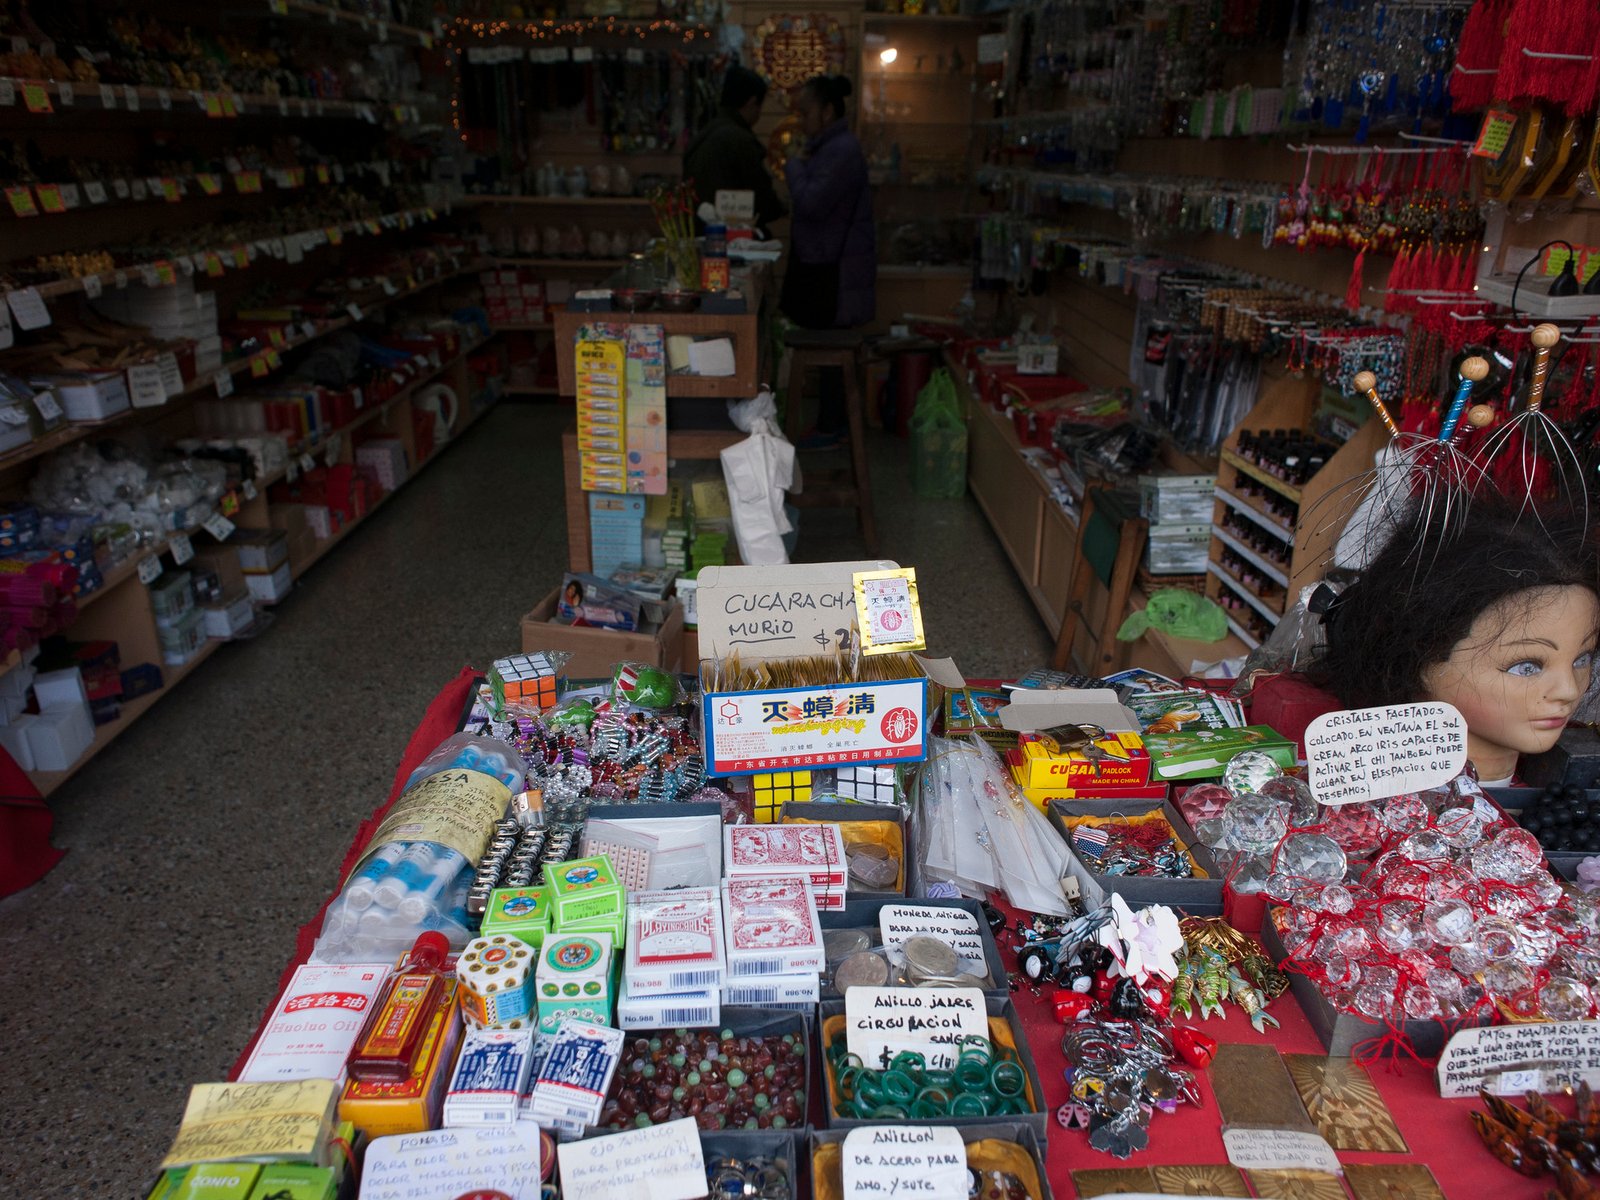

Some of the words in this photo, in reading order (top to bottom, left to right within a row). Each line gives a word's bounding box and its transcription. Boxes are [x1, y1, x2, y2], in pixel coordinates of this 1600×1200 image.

[728, 619, 794, 636] MURIO
[1386, 706, 1444, 720] FACETADOS
[1425, 719, 1438, 729] EL
[1447, 733, 1461, 743] DE
[1430, 760, 1451, 770] QUE
[1102, 767, 1131, 775] PADLOCK
